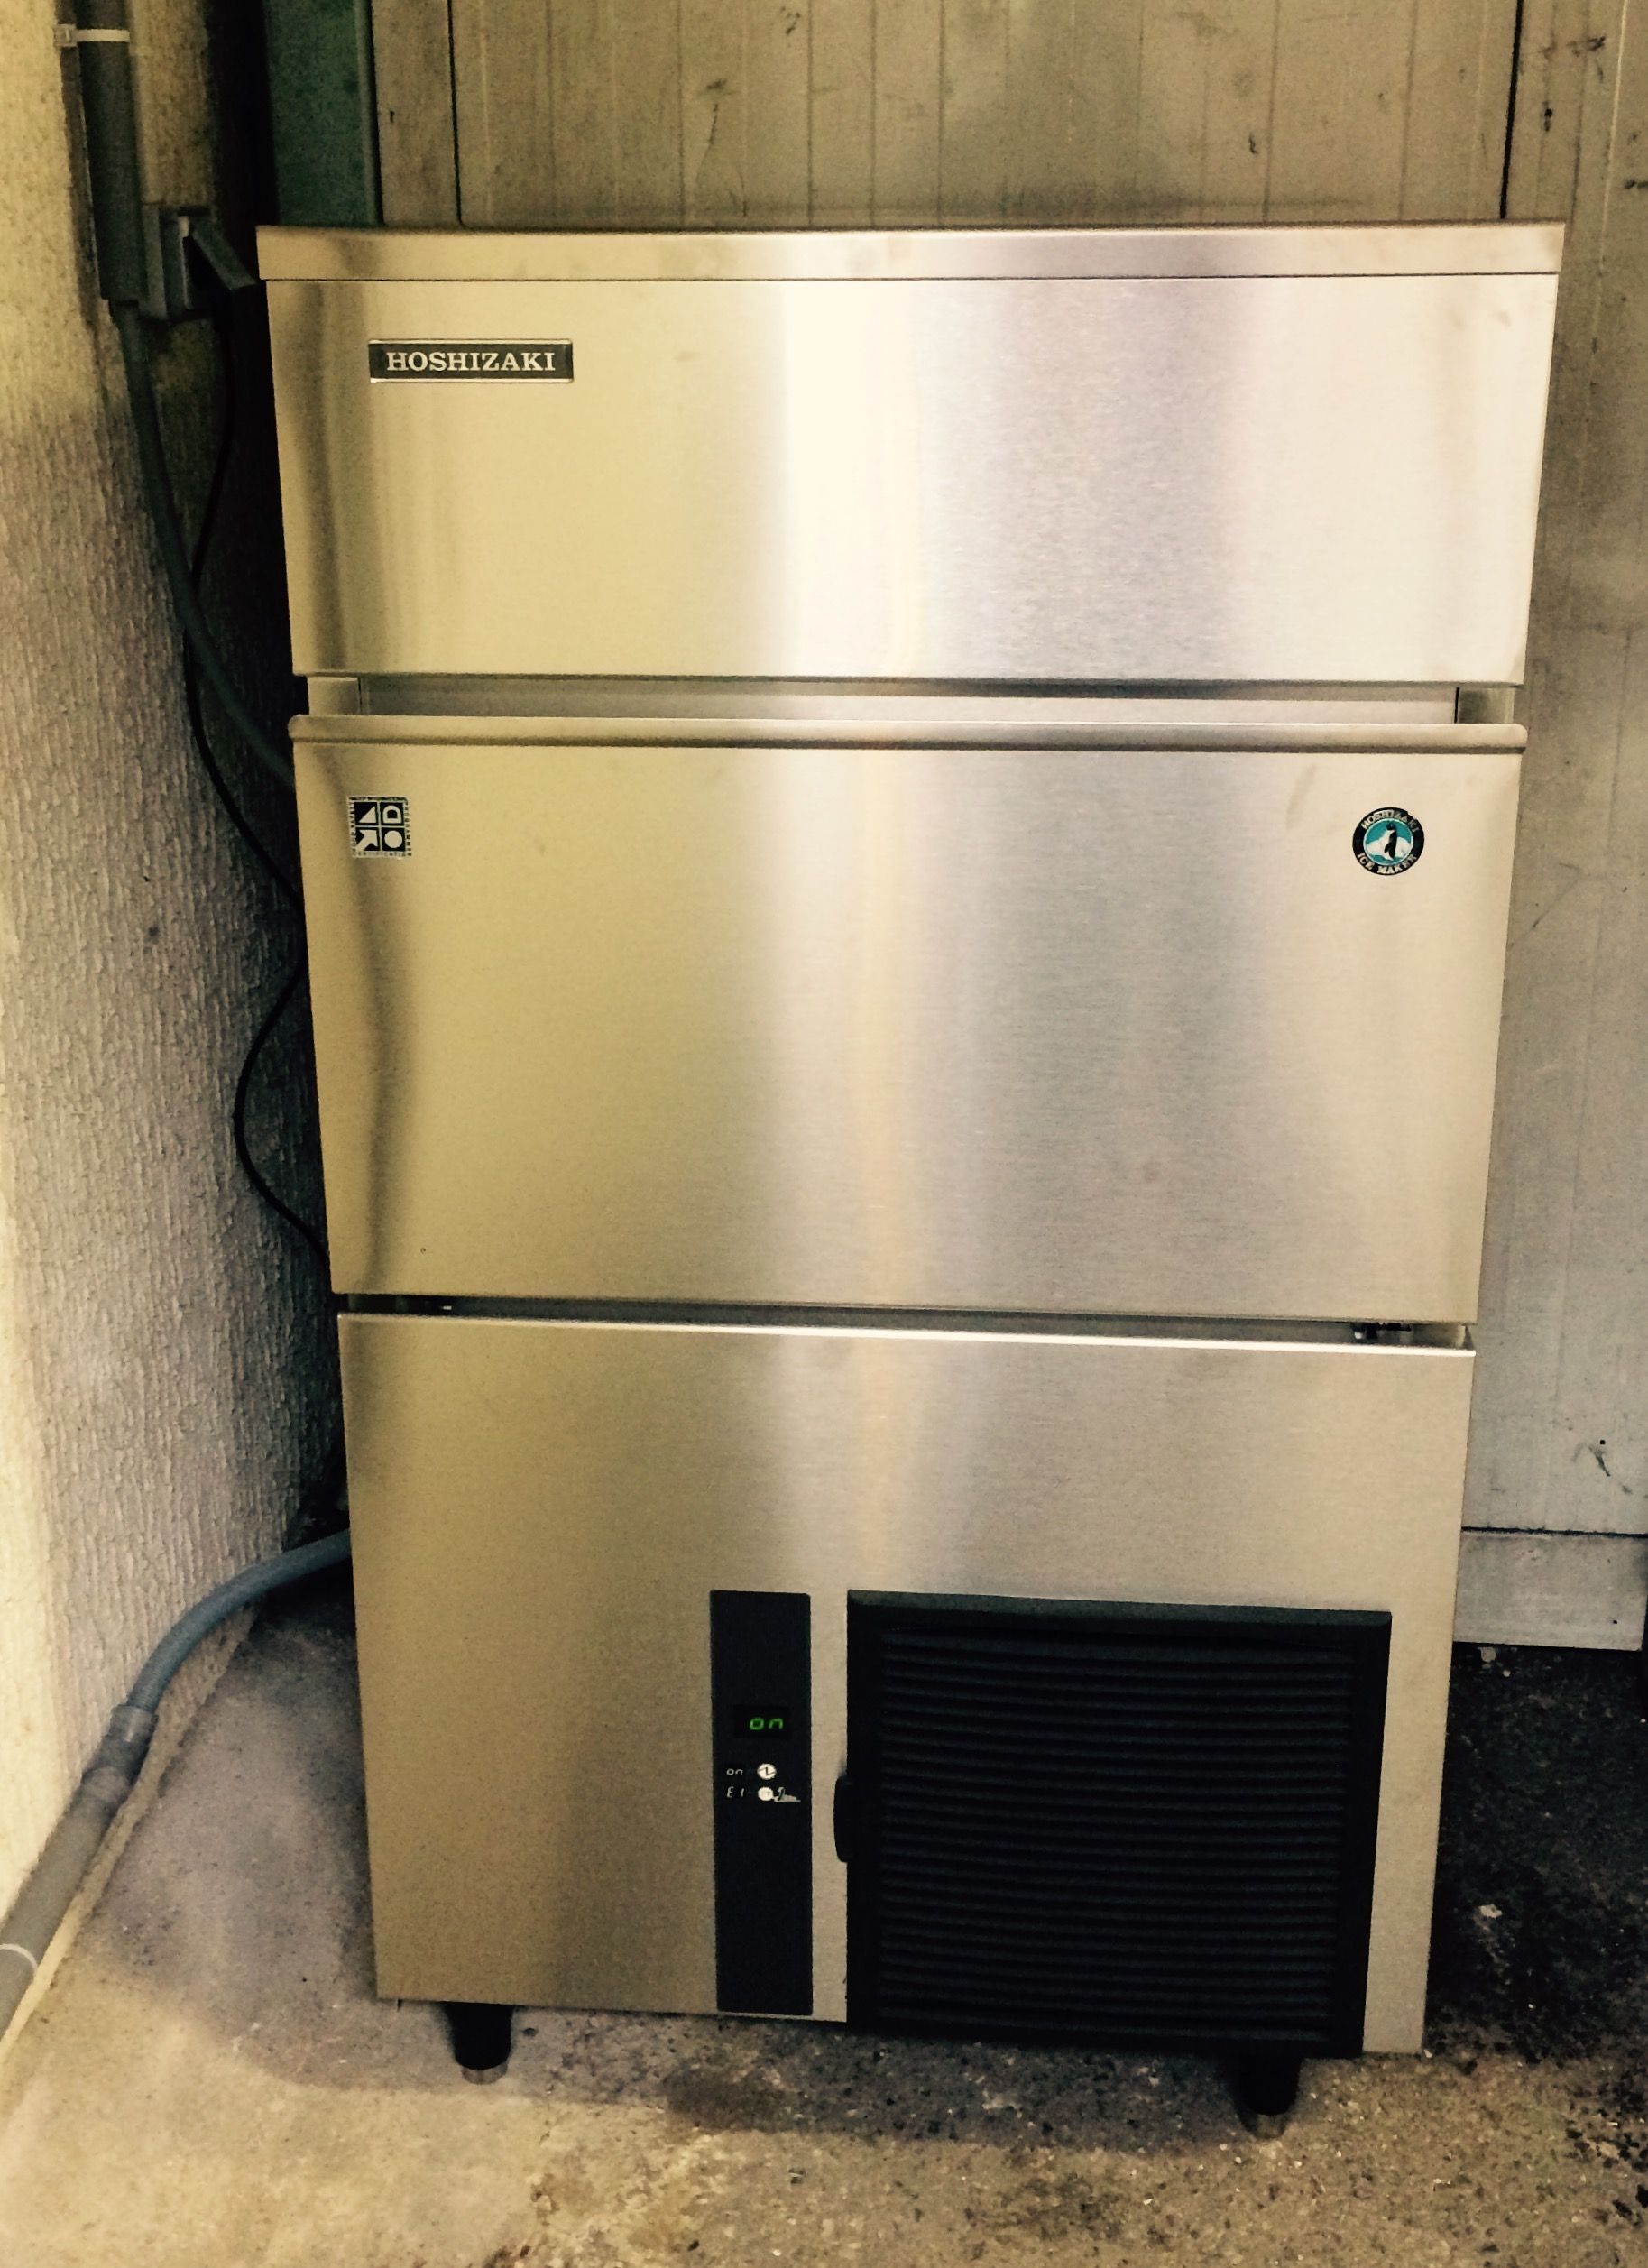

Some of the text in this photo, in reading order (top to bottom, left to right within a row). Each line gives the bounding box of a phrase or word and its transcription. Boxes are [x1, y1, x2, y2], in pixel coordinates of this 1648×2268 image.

[386, 351, 556, 372] HOSHIZAKI
[1357, 853, 1417, 874] ICE MAKER
[749, 1717, 784, 1730] on
